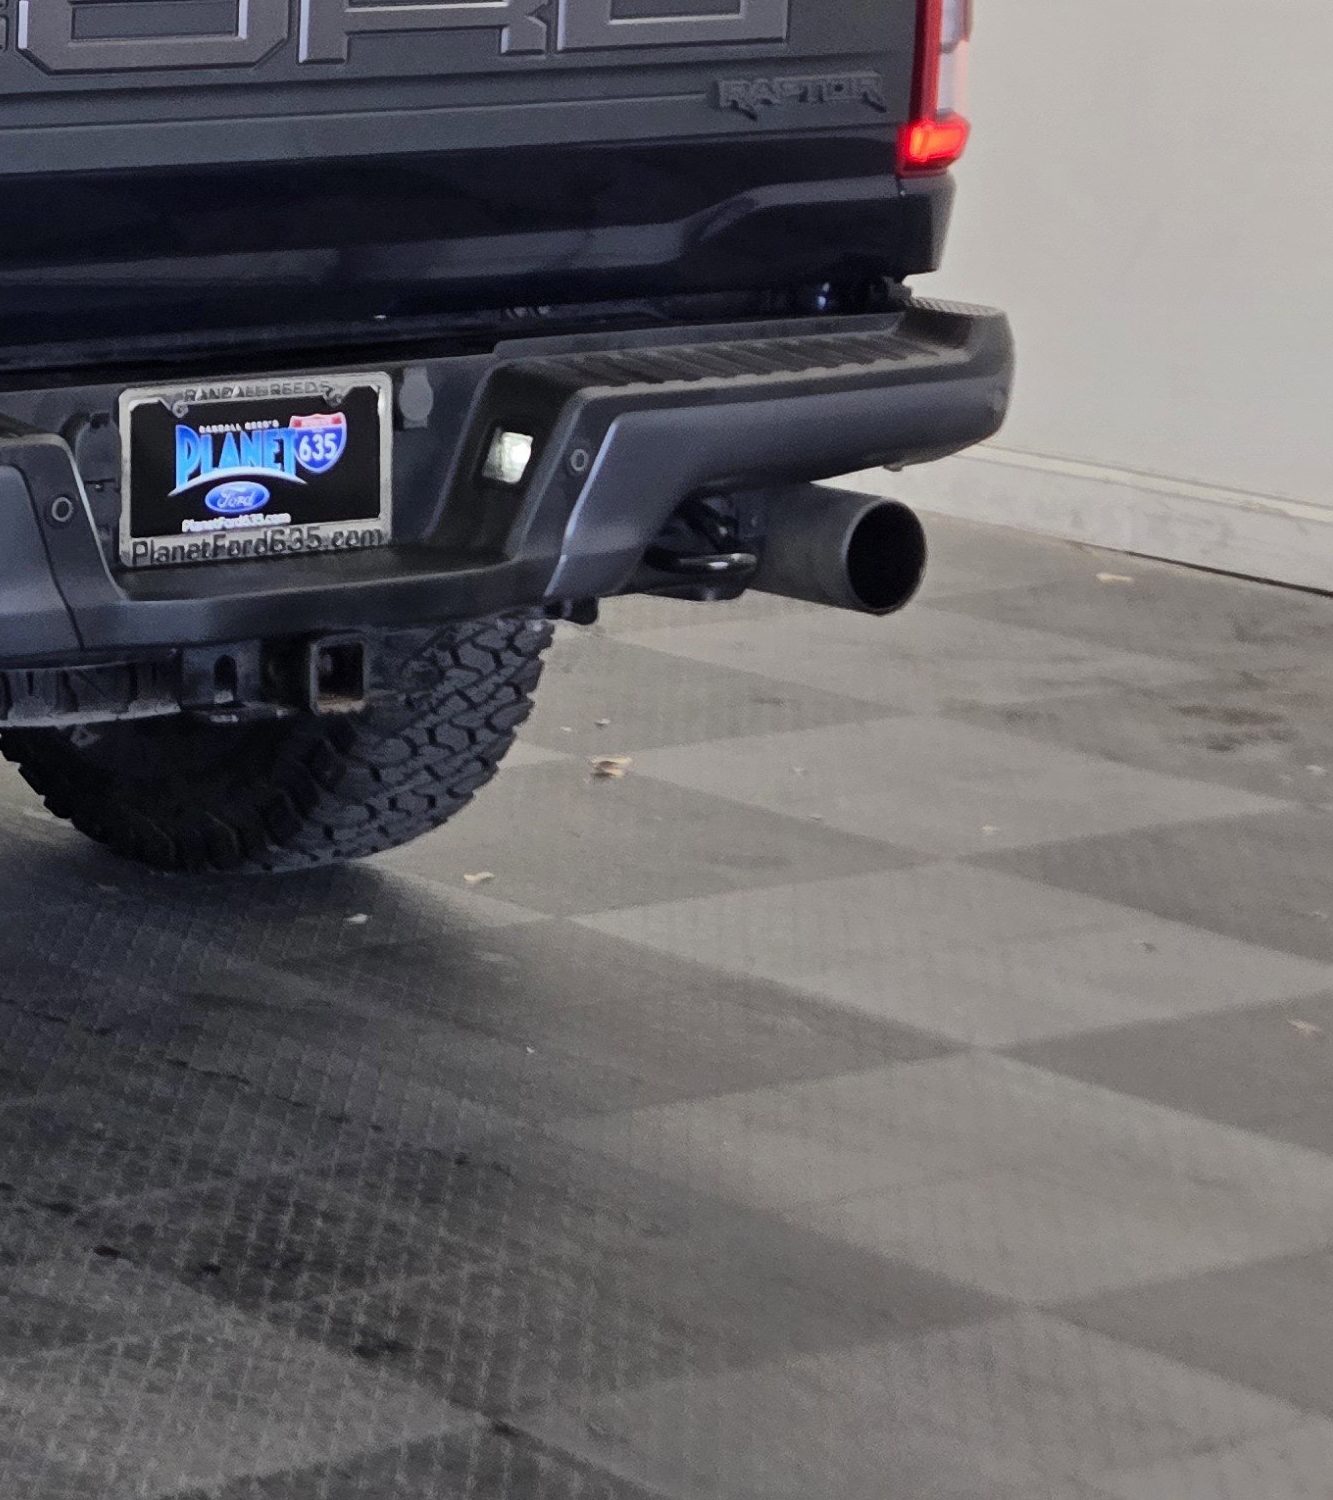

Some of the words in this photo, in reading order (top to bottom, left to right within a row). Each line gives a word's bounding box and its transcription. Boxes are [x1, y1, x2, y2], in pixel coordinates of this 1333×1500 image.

[713, 70, 886, 122] RAPTOR
[175, 424, 297, 492] PLANET
[299, 432, 337, 463] 635
[216, 489, 256, 509] Ford
[133, 526, 383, 565] PlanetFord635.com
